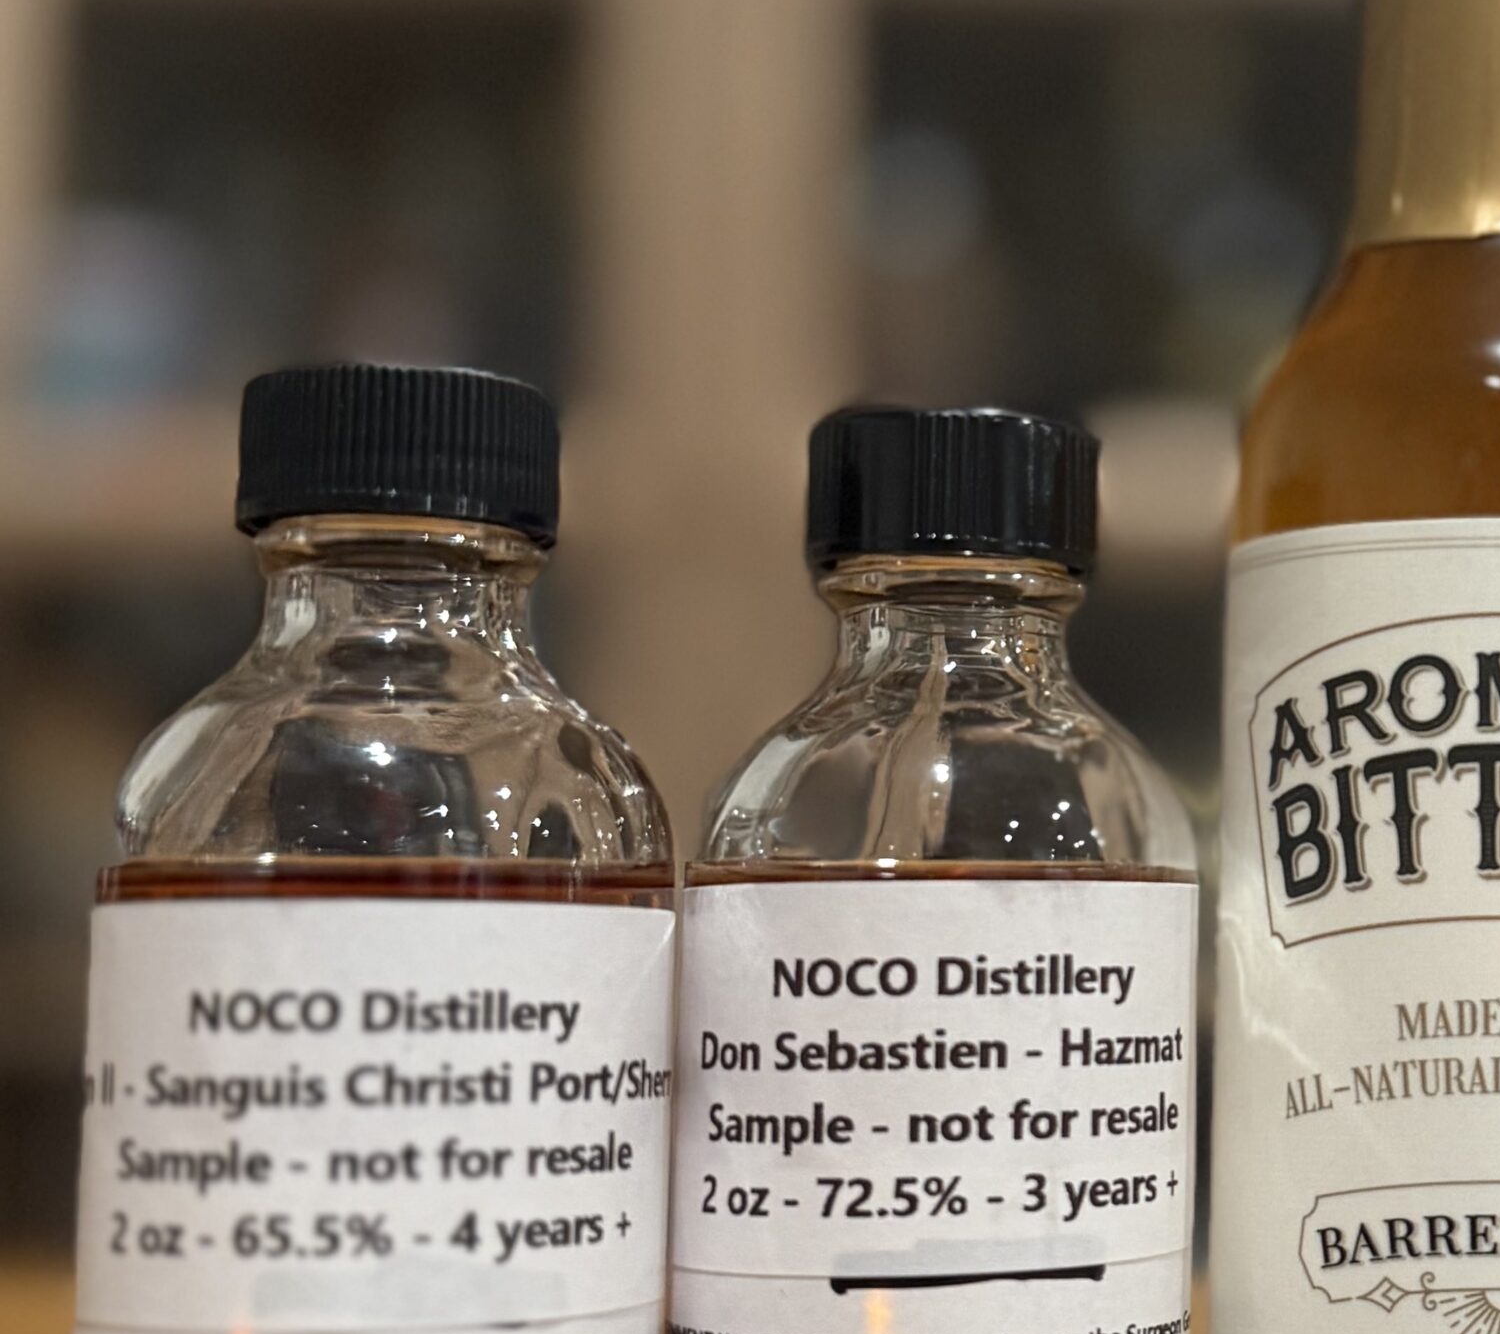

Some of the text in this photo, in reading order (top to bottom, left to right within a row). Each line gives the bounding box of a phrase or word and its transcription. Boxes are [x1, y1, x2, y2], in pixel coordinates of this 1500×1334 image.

[773, 953, 1135, 1005] NOCO Distillery
[189, 989, 580, 1044] NOCO Distillery
[701, 1026, 1183, 1072] Don Sebastien Hazmat
[145, 1063, 327, 1121] Sanguis
[344, 1062, 511, 1107] Christi
[708, 1090, 1179, 1156] Sample not for resale
[116, 1130, 633, 1198] Sample not for resale
[702, 1172, 1158, 1222] 2 oz 72.5% 3 years
[109, 1209, 604, 1265] 2 oz 65.5% 4 years
